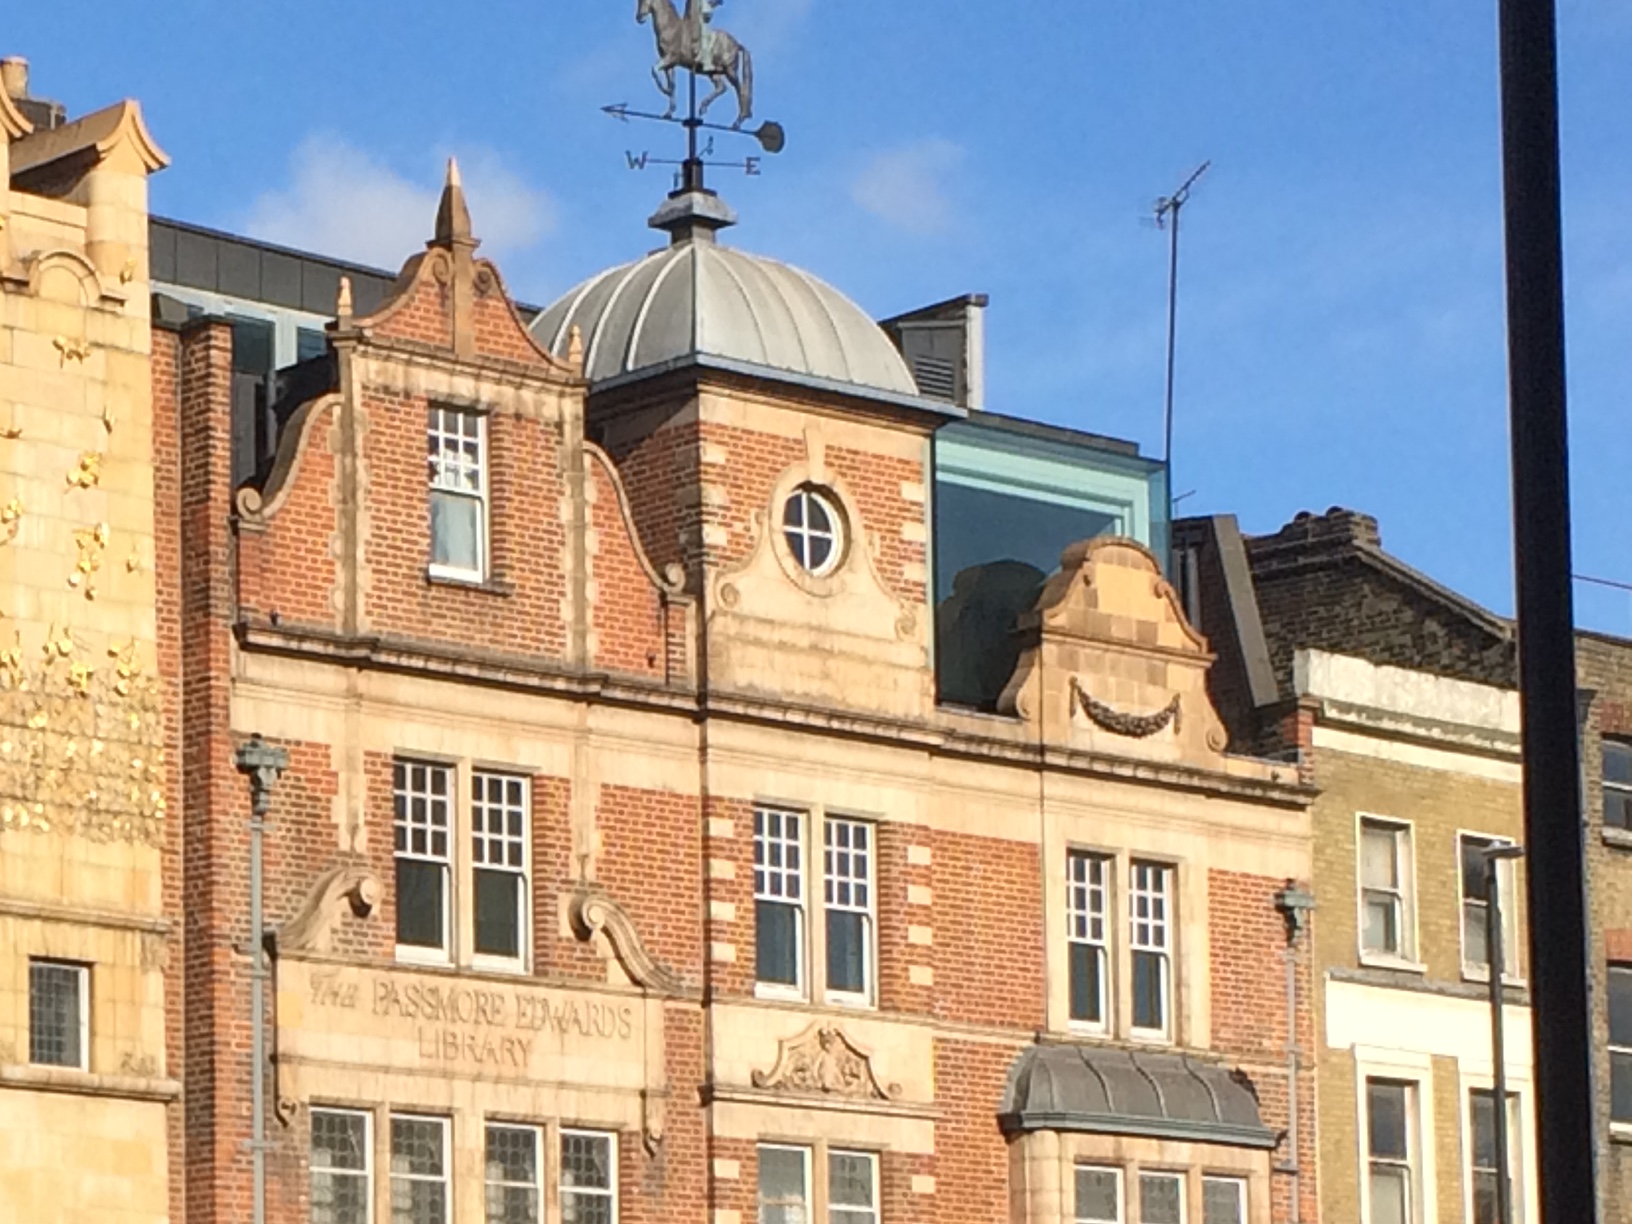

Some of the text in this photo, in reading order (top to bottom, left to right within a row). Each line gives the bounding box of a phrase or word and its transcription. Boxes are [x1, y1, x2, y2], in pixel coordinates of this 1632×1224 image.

[372, 978, 505, 1026] PASSMORE
[515, 993, 631, 1039] EDWARDS
[419, 1026, 532, 1068] LIBRARY
